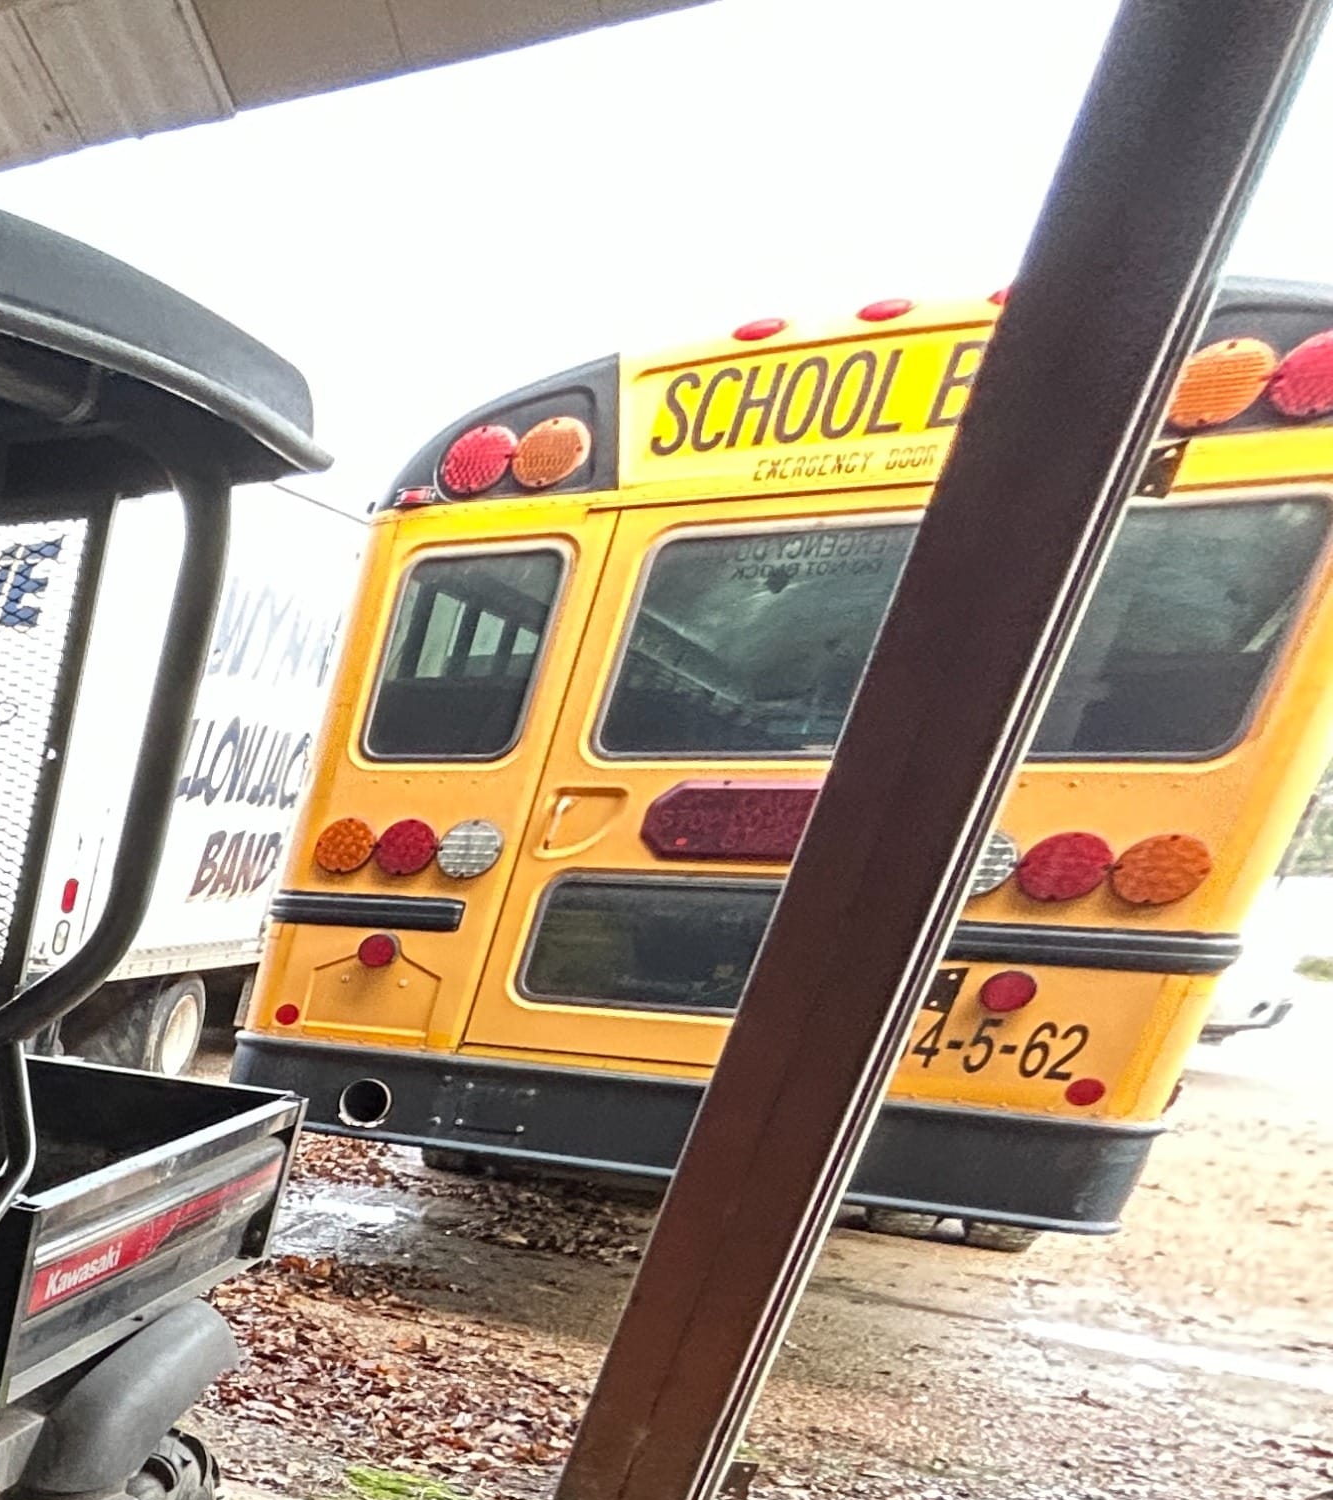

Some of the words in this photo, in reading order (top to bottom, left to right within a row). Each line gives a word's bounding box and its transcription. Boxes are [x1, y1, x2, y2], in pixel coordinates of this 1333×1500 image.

[650, 349, 904, 456] SCHOOL
[925, 340, 988, 430] B
[753, 451, 874, 481] EMERGENCY
[885, 444, 938, 471] DOOR
[207, 575, 341, 688] WYNN
[188, 829, 283, 901] BAND
[905, 1013, 1089, 1081] 4-5-62
[44, 1243, 123, 1299] Kawasaki
